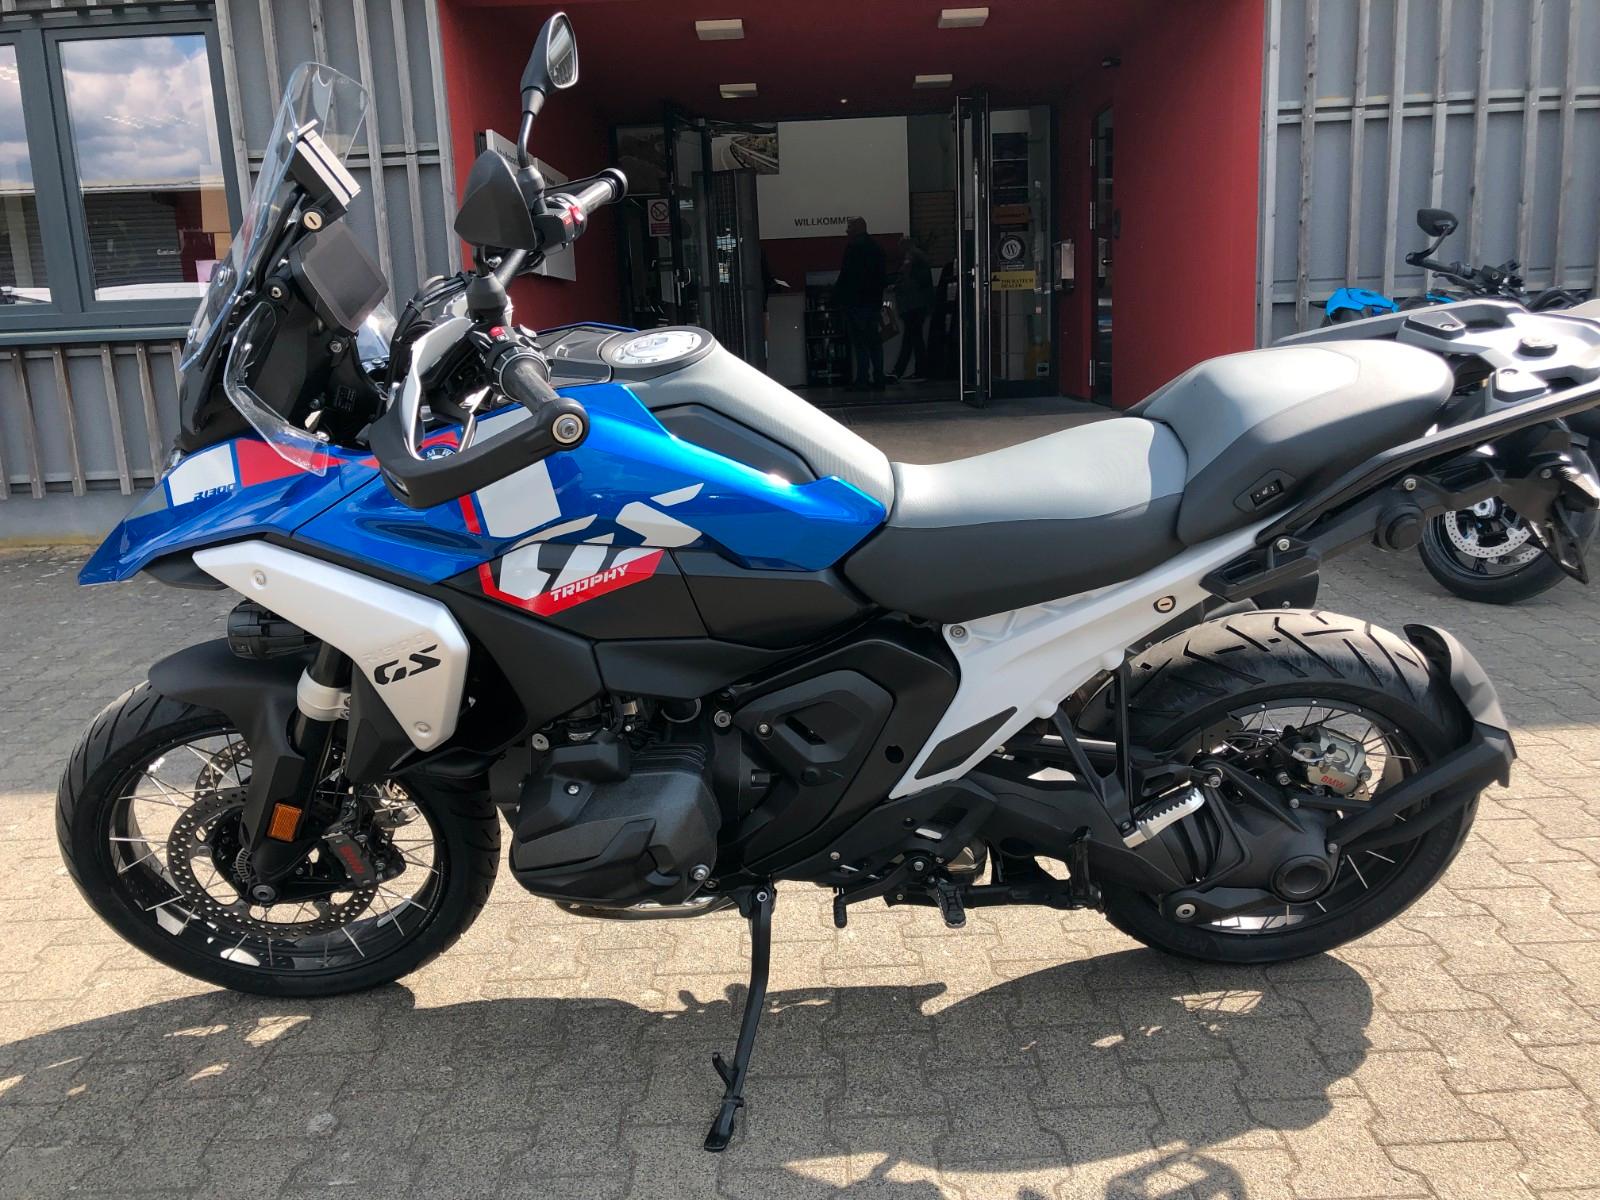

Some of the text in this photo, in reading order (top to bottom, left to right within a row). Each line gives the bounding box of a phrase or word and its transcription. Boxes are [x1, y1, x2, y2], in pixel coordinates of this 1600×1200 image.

[499, 483, 705, 602] GS
[549, 563, 629, 602] TROPHY
[373, 643, 442, 686] GS
[1321, 775, 1345, 788] BMW
